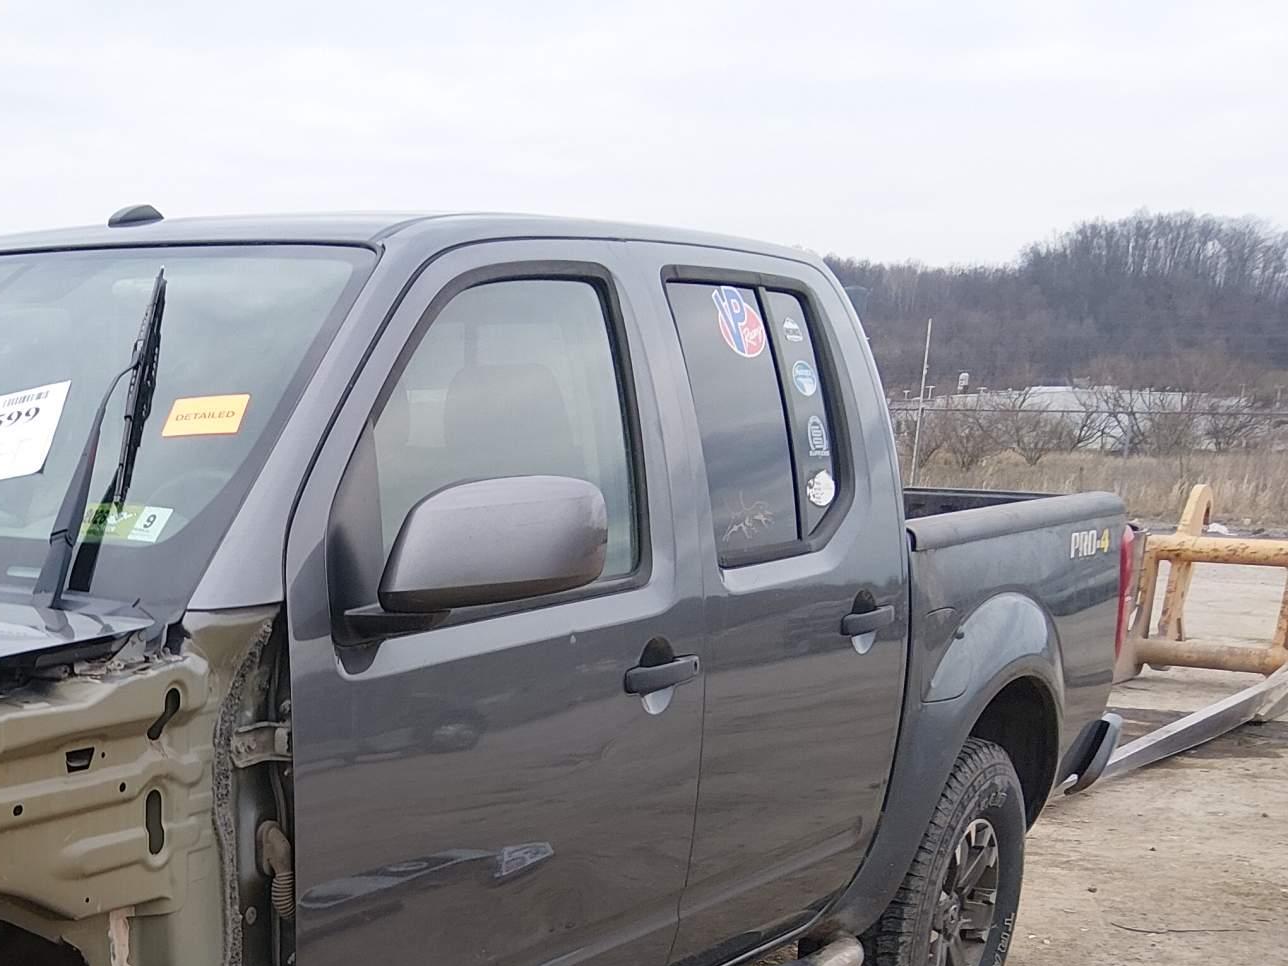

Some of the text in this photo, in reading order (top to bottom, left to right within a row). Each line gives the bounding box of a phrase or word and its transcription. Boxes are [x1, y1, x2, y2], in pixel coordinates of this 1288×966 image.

[175, 410, 236, 422] DETAILED
[143, 514, 158, 529] 9
[1069, 528, 1111, 559] PRO-4
